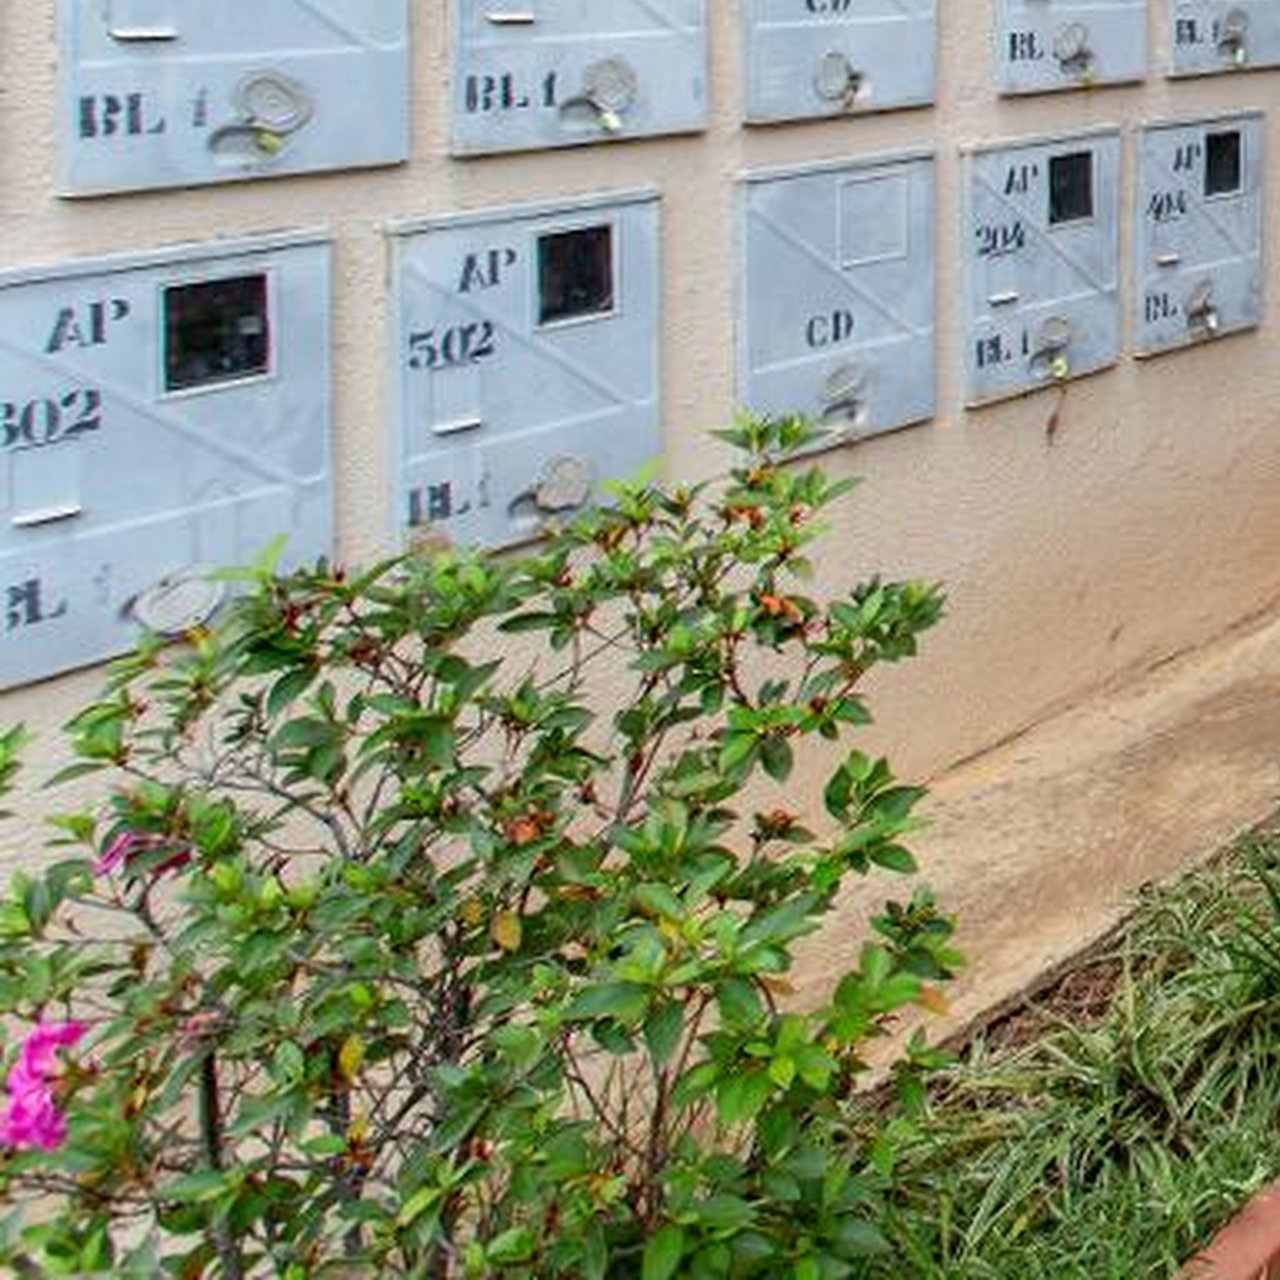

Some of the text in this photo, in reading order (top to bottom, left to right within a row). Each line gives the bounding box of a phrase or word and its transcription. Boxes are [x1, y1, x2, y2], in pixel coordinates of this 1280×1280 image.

[466, 73, 528, 112] BL
[80, 93, 165, 138] BL
[458, 247, 516, 293] AP
[45, 300, 130, 354] AP
[408, 320, 495, 368] 502
[806, 310, 853, 347] CD
